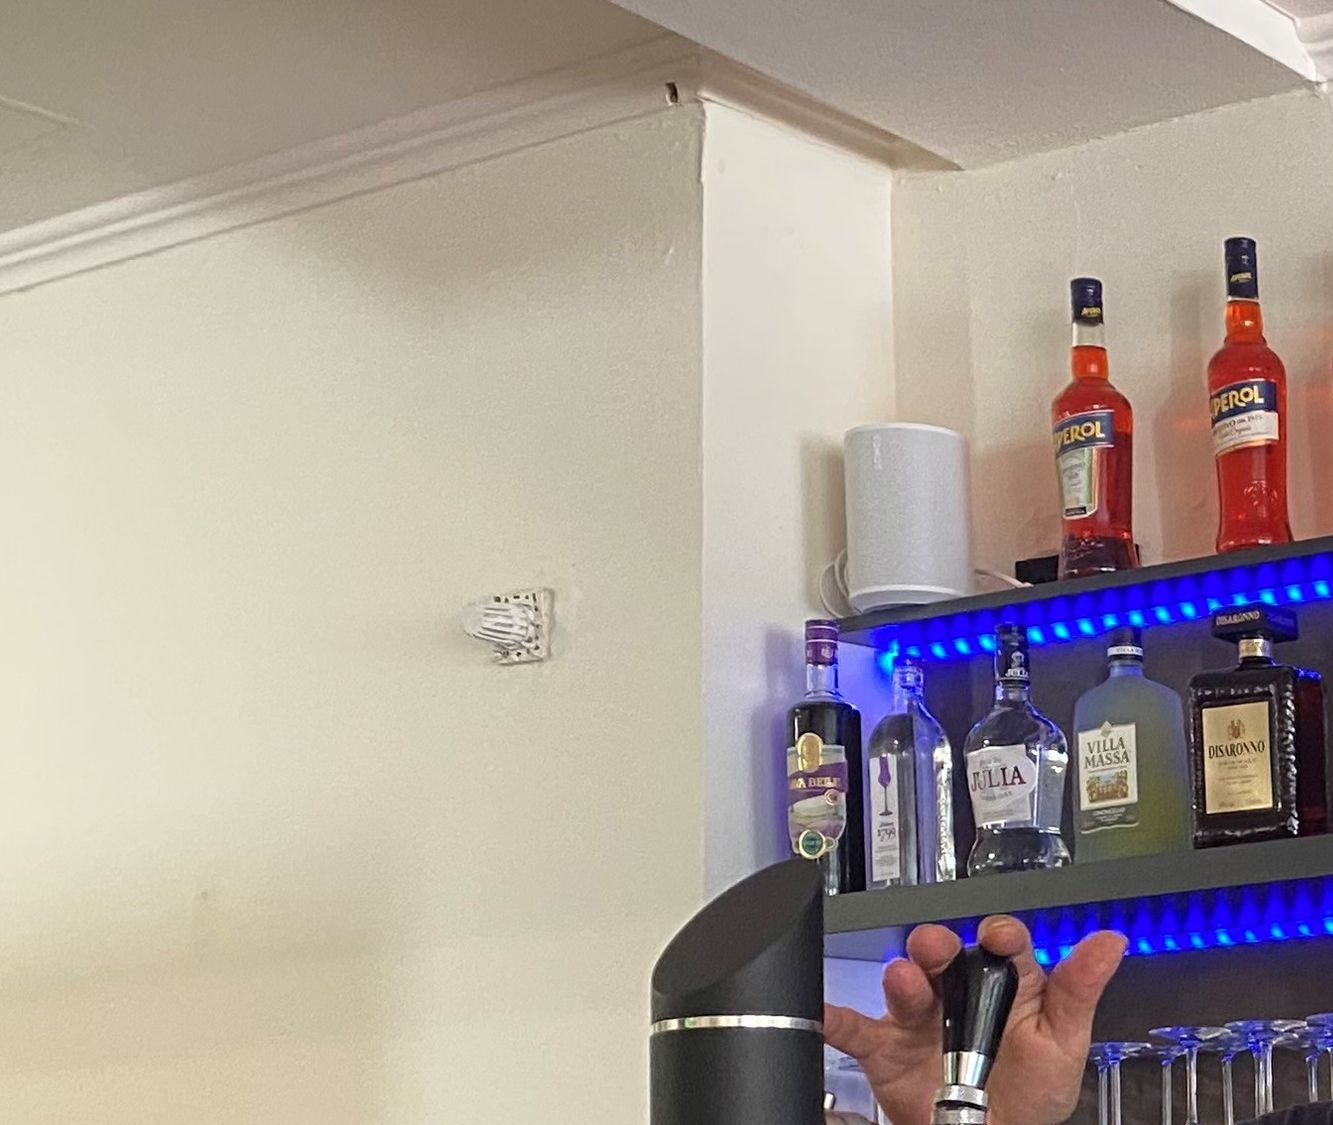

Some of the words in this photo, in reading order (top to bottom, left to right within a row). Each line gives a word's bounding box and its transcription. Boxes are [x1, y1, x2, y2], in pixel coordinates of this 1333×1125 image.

[1087, 737, 1126, 755] VILLA
[1208, 740, 1265, 759] DISARONNO
[1084, 751, 1130, 770] MASSA
[971, 765, 1027, 792] JULIA
